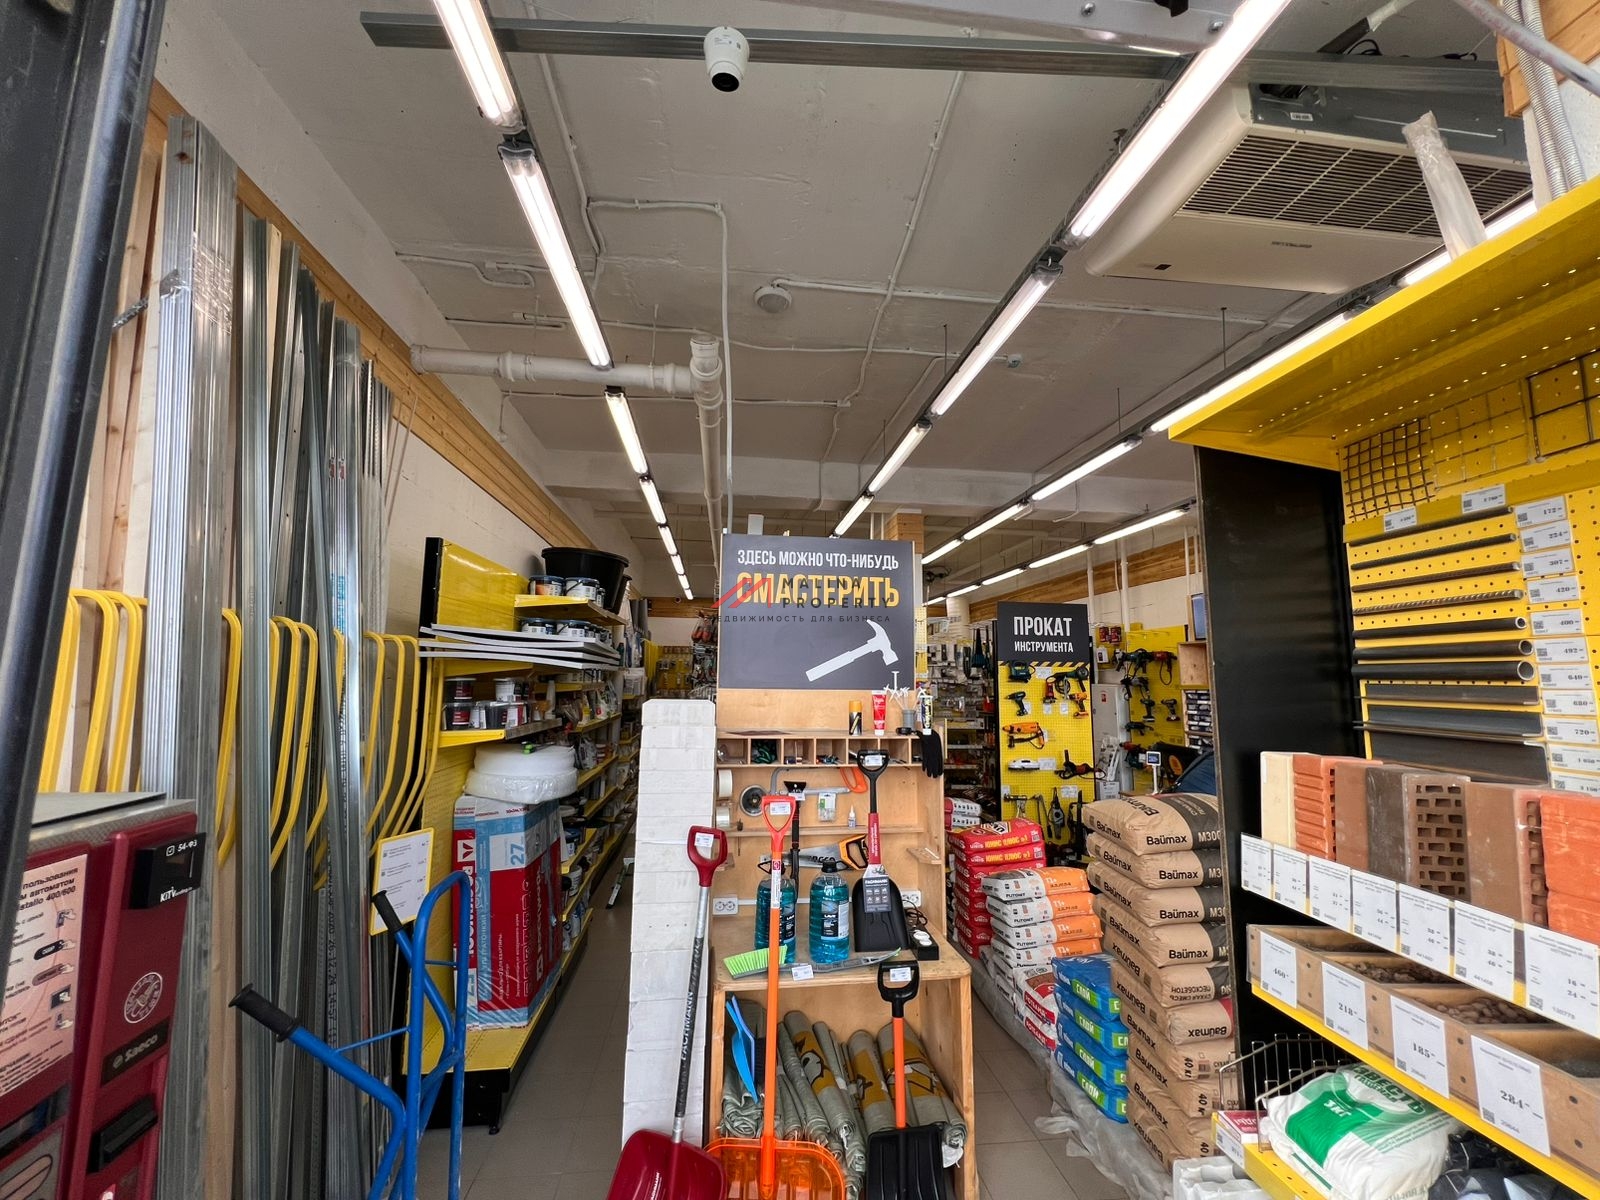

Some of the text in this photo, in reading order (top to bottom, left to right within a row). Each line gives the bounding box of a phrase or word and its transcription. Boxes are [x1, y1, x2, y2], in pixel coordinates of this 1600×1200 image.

[738, 550, 899, 570] ЗДЕСЬ МОЖНО ЧТО-НИБУДЬ
[736, 572, 900, 607] СМАСТЕРИТЬ
[1013, 616, 1073, 637] ПРОКАТ
[1014, 641, 1074, 653] ИНСТРУМЕНТА
[1146, 834, 1187, 845] Baümax
[510, 842, 524, 866] 27
[1159, 870, 1198, 880] Baümax
[1160, 910, 1199, 919] Baümax
[1169, 949, 1208, 959] Baümax
[1188, 1026, 1227, 1038] Baümax
[125, 1034, 158, 1062] Saeco
[1351, 1062, 1426, 1114] ЗВЕСТЬ
[1198, 1093, 1207, 1106] 40
